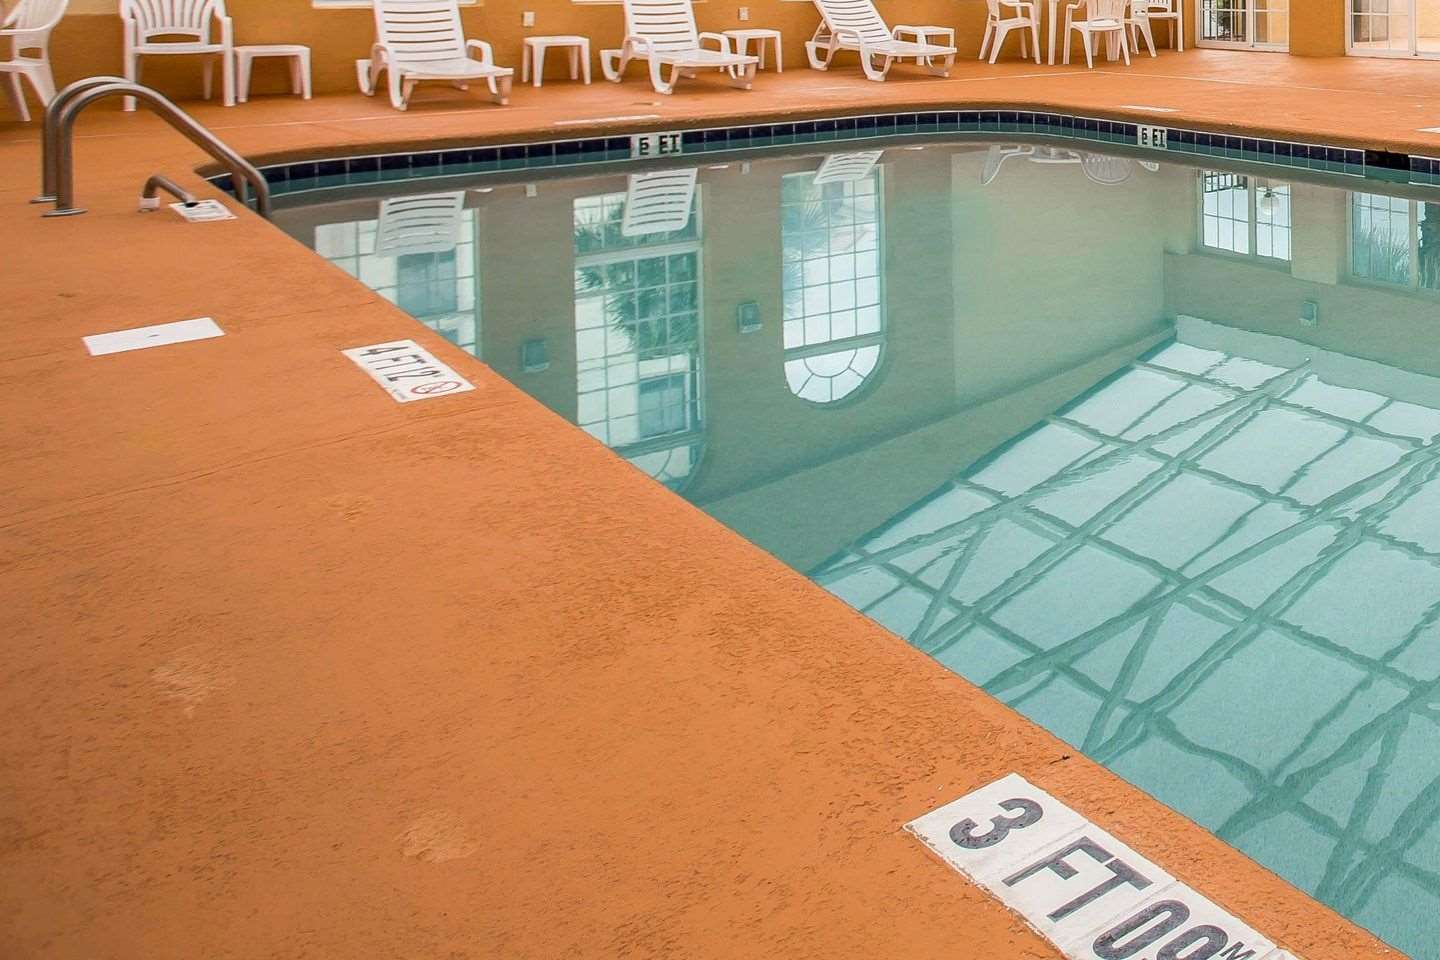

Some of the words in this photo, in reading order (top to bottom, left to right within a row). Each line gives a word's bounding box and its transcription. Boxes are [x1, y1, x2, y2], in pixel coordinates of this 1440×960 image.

[360, 346, 409, 356] 4
[368, 354, 427, 370] FT
[948, 798, 1044, 849] 3
[1002, 836, 1154, 922] FT
